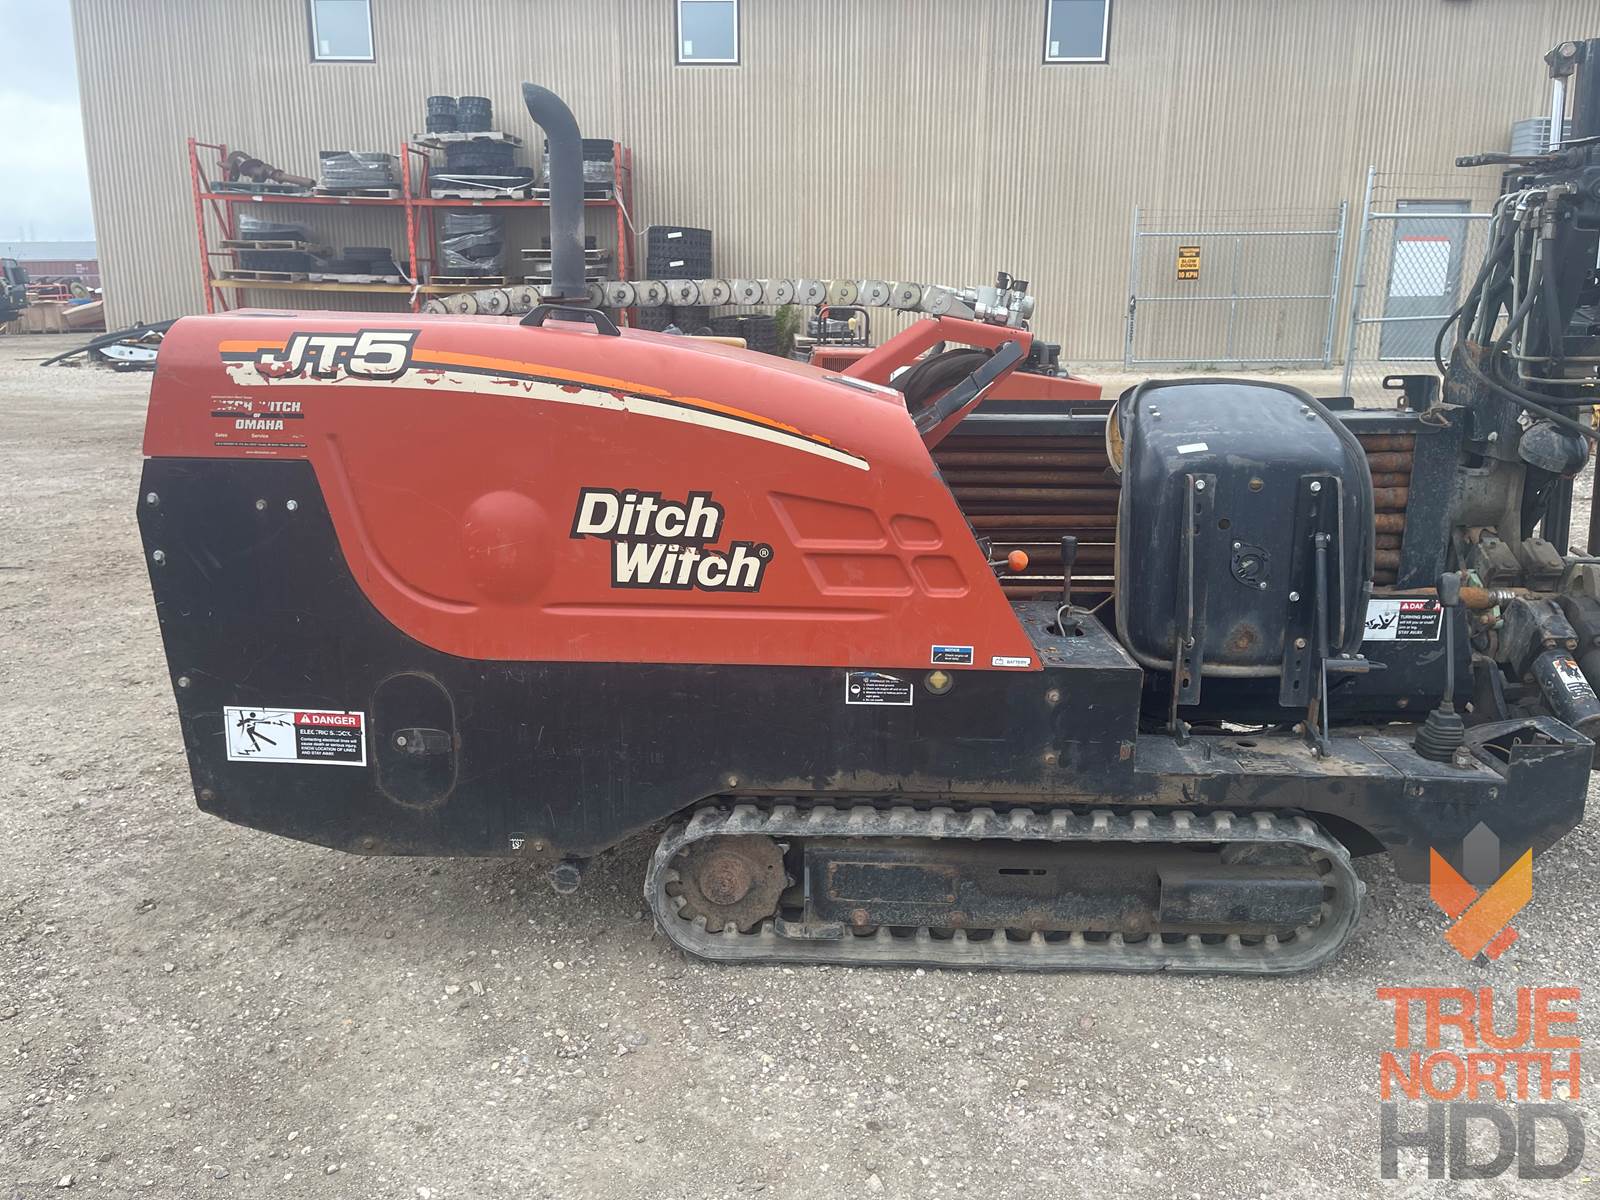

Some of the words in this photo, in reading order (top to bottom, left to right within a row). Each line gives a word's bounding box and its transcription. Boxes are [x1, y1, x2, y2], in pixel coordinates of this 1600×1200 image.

[259, 331, 415, 376] JT5
[259, 401, 301, 412] ITCH
[235, 420, 284, 430] OMAHA
[576, 492, 719, 538] Ditch
[312, 715, 356, 725] DANGER
